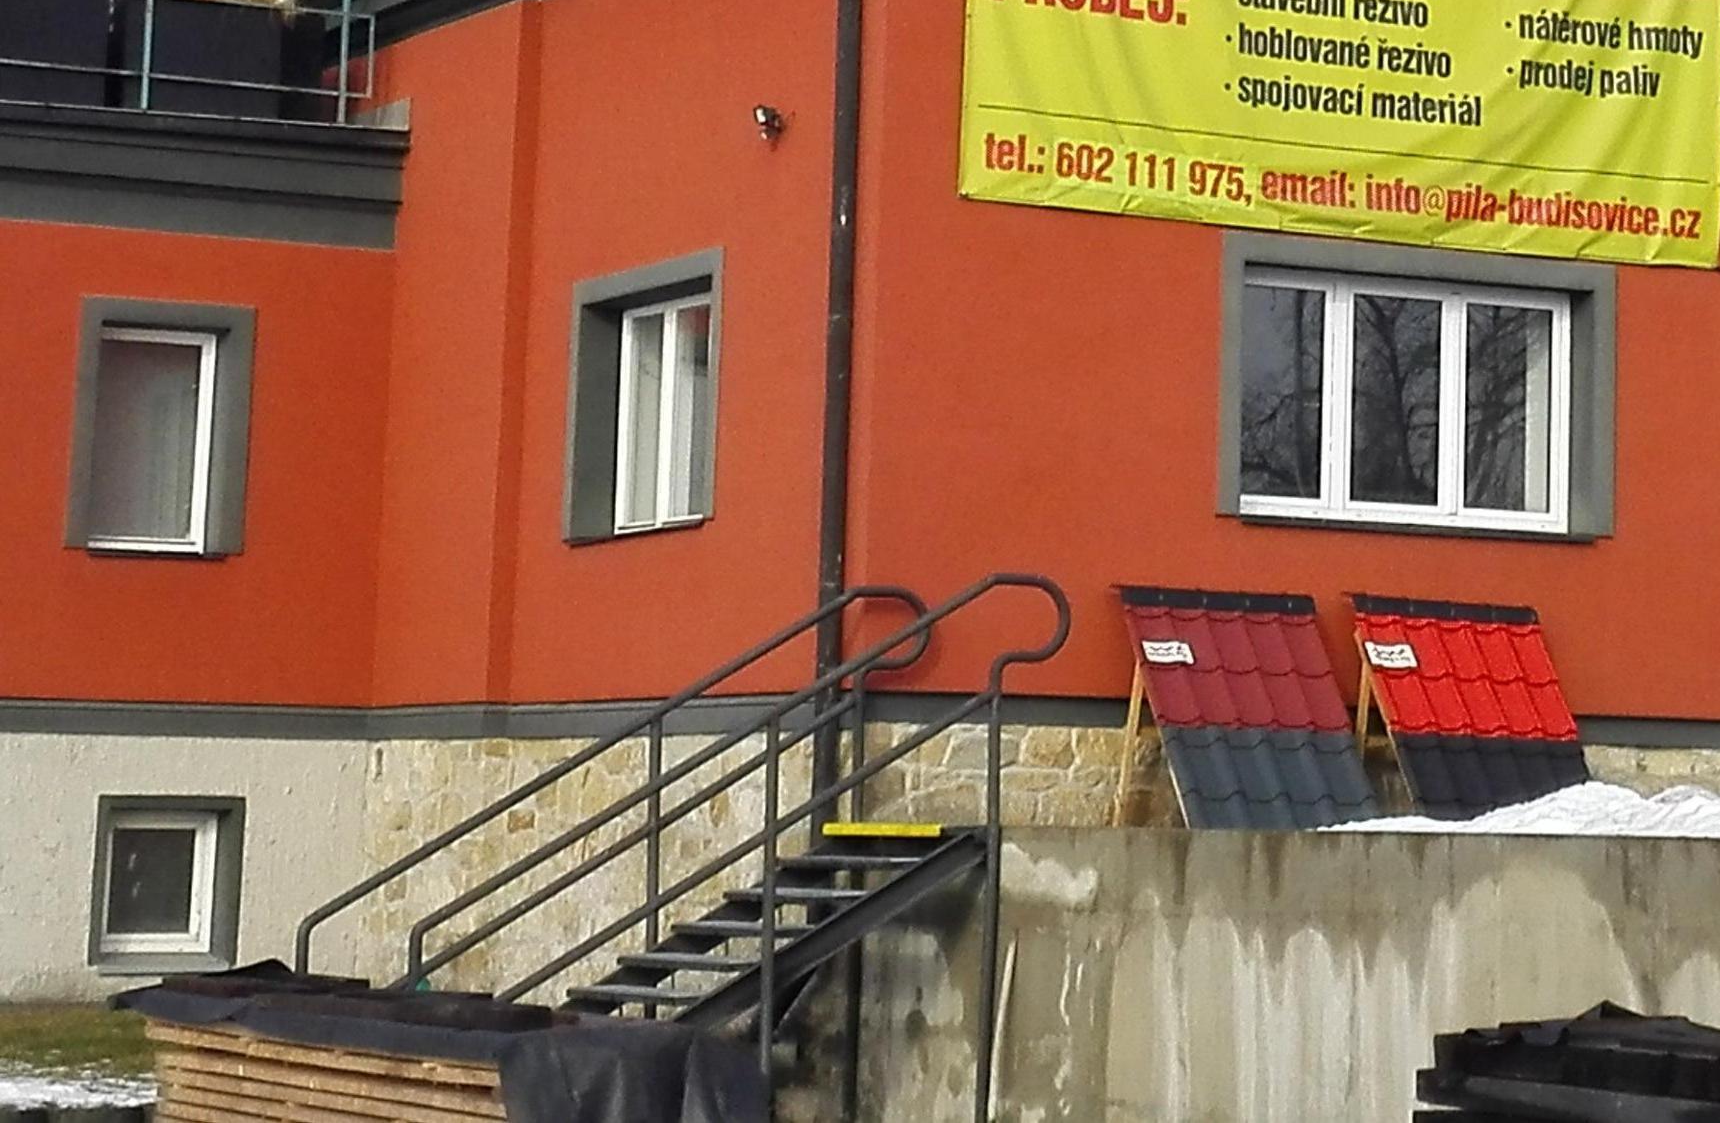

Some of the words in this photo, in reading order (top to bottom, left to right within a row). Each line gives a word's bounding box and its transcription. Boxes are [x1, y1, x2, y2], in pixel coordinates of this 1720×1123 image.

[1238, 22, 1370, 68] hoblované
[1376, 36, 1452, 79] řezivo
[1518, 8, 1623, 50] nátěrové
[1628, 26, 1704, 61] hmoty
[1237, 76, 1364, 116] spojovací
[1370, 92, 1482, 128] materiál
[1518, 59, 1594, 96] prodej
[1599, 68, 1661, 98] paliv
[985, 133, 1046, 175] tel.:
[1055, 141, 1115, 184] 602
[1124, 151, 1176, 192] 111
[1187, 160, 1252, 208] 975,
[1260, 169, 1356, 211] email:
[1365, 174, 1702, 241] info@pila-budisovice.cz
